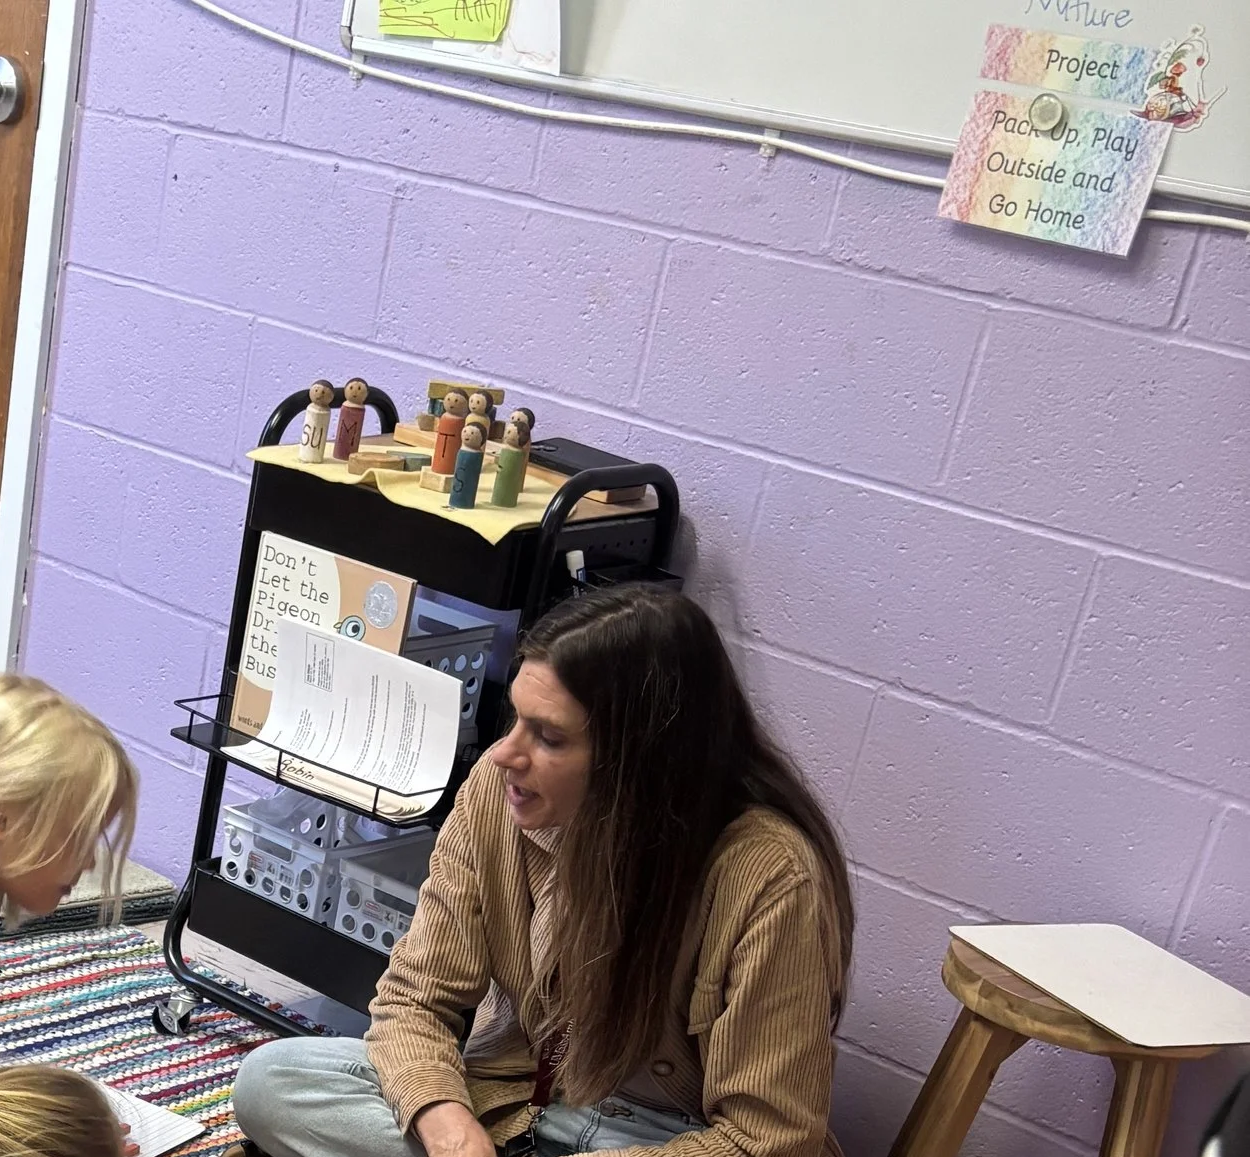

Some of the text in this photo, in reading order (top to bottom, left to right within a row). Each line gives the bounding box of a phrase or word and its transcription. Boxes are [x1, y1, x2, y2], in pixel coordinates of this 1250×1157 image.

[1045, 49, 1120, 81] Project
[1050, 121, 1081, 150] Up,
[1091, 127, 1140, 162] Play
[986, 152, 1117, 193] Outside and
[988, 194, 1086, 230] Go Home
[301, 423, 324, 450] SU
[338, 418, 359, 448] M
[438, 431, 456, 459] T
[452, 466, 467, 493] S
[262, 544, 318, 578] Don't
[259, 567, 330, 605] Let the
[252, 610, 279, 635] Dr
[255, 590, 322, 627] Pigeon
[250, 633, 279, 658] the
[244, 654, 278, 681] Bus
